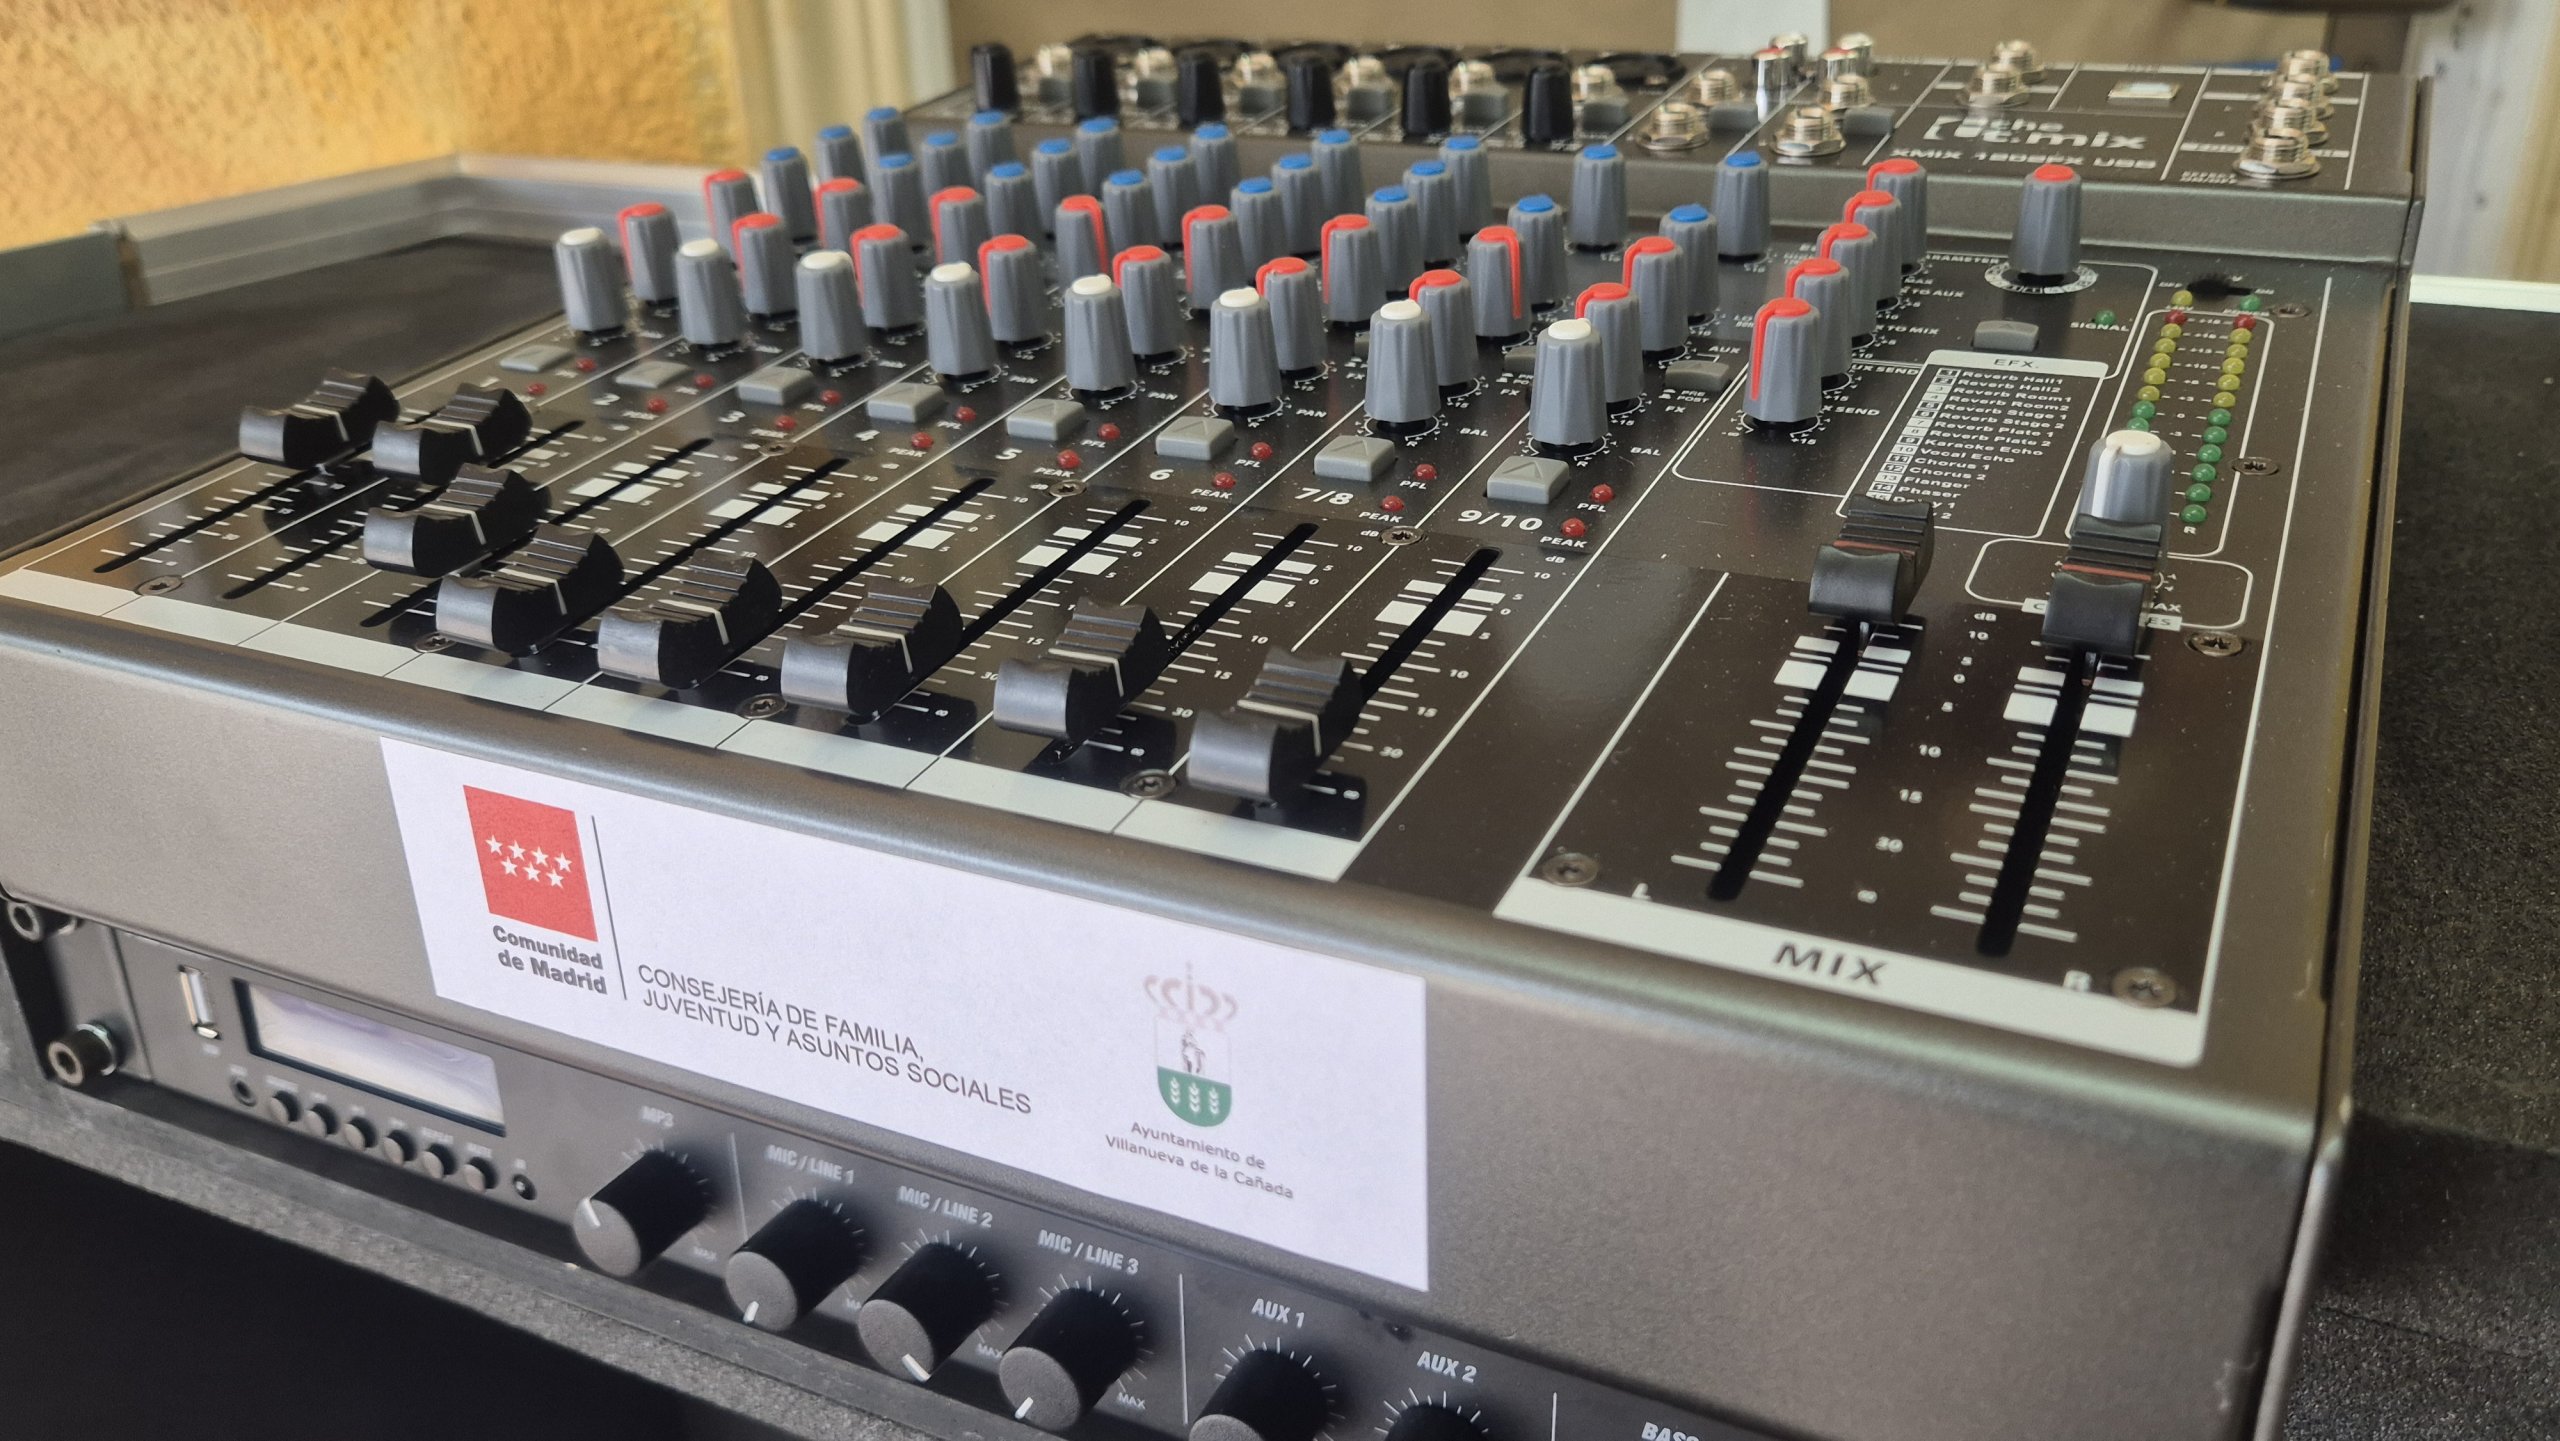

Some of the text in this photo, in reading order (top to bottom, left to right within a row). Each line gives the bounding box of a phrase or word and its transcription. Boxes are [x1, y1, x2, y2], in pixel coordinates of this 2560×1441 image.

[1889, 148, 1964, 160] XMIX
[1925, 254, 1999, 264] ARAMETER
[1909, 327, 1939, 335] MIX
[2070, 321, 2129, 332] SIGNAL
[1708, 345, 1741, 354] AUX
[1875, 366, 1919, 375] SEND
[1009, 375, 1039, 384] PAN
[1962, 371, 2019, 382] Reverb
[1957, 379, 2014, 390] Reverb
[1148, 391, 1178, 400] PAN
[1500, 389, 1521, 397] FX
[1953, 387, 2010, 398] Reverb
[1677, 395, 1710, 403] POST
[1949, 395, 2006, 406] Reverb
[1296, 408, 1327, 418] PAN
[1665, 405, 1687, 413] FX
[1835, 406, 1880, 416] SEND
[1944, 404, 2002, 415] Reverb
[2006, 408, 2054, 421] Stage
[1939, 412, 1998, 424] Reverb
[2002, 417, 2052, 429] Stage
[1459, 427, 1489, 437] BAL
[1934, 421, 1994, 433] Reverb
[1999, 426, 2041, 437] Plate
[1080, 439, 1107, 448] PFL
[1930, 430, 1990, 442] Reverb
[1994, 435, 2037, 446] Plate
[1630, 447, 1662, 456] BAL
[1924, 439, 1994, 452] Karaoke
[1999, 446, 2044, 456] Echo
[995, 447, 1023, 460] 5
[1920, 448, 1967, 459] Vocal
[1971, 453, 2015, 463] Echo
[1234, 458, 1261, 468] PFL
[1914, 457, 1977, 470] Chorus
[1033, 467, 1075, 477] PEAK
[1149, 468, 1175, 480] 6
[1909, 466, 1972, 480] Chorus
[1400, 480, 1427, 490] PFL
[1904, 476, 1971, 490] Flanger
[1190, 488, 1233, 500] PEAK
[1294, 487, 1355, 505] 7/8
[1898, 486, 1961, 499] Phaser
[1576, 502, 1607, 513] PFL
[1893, 496, 1943, 508] Dey
[1189, 505, 1208, 513] dB
[1358, 510, 1403, 524] PEAK
[1457, 509, 1543, 531] 9/10
[1174, 519, 1189, 527] 10
[1360, 528, 1379, 537] dB
[2183, 526, 2197, 535] R
[1539, 535, 1587, 549] PEAK
[1346, 544, 1363, 553] 10
[1545, 554, 1565, 564] dB
[1533, 570, 1551, 580] 10
[1511, 593, 1524, 601] 5
[1284, 600, 1296, 608] 5
[1500, 607, 1511, 616] 0
[1973, 611, 1997, 622] dB
[1025, 636, 1045, 646] 15
[1250, 635, 1269, 646] 10
[1478, 631, 1491, 640] 5
[1968, 630, 1989, 641] 10
[1213, 670, 1233, 681] 15
[1449, 668, 1470, 680] 10
[1953, 673, 1966, 684] 0
[1171, 707, 1194, 719] 30
[1416, 706, 1439, 718] 15
[1378, 746, 1404, 759] 30
[1918, 744, 1942, 758] 10
[493, 925, 604, 970] Comunidad
[1773, 942, 1888, 986] MIX
[497, 949, 608, 995] de Madrid
[638, 964, 924, 1062] CONSEJERÍA DE FAMILIA,
[642, 989, 1032, 1115] JUVENTUD Y ASUNTOS SOCIALES
[1131, 1121, 1266, 1171] Ayuntamiento de
[766, 1144, 796, 1168] MIC
[809, 1156, 842, 1179] LINE
[844, 1167, 856, 1184] 1
[1105, 1133, 1294, 1200] Villanueva de la Cañada
[898, 1185, 929, 1210] MIC
[943, 1198, 979, 1225] LINE
[979, 1210, 994, 1229] 2
[1038, 1229, 1073, 1254] MIC
[1086, 1242, 1124, 1271] LINE
[1125, 1256, 1141, 1275] 3
[1250, 1297, 1307, 1328] AUX 1
[1416, 1350, 1478, 1384] AUX 2
[1117, 1391, 1147, 1411] MAX
